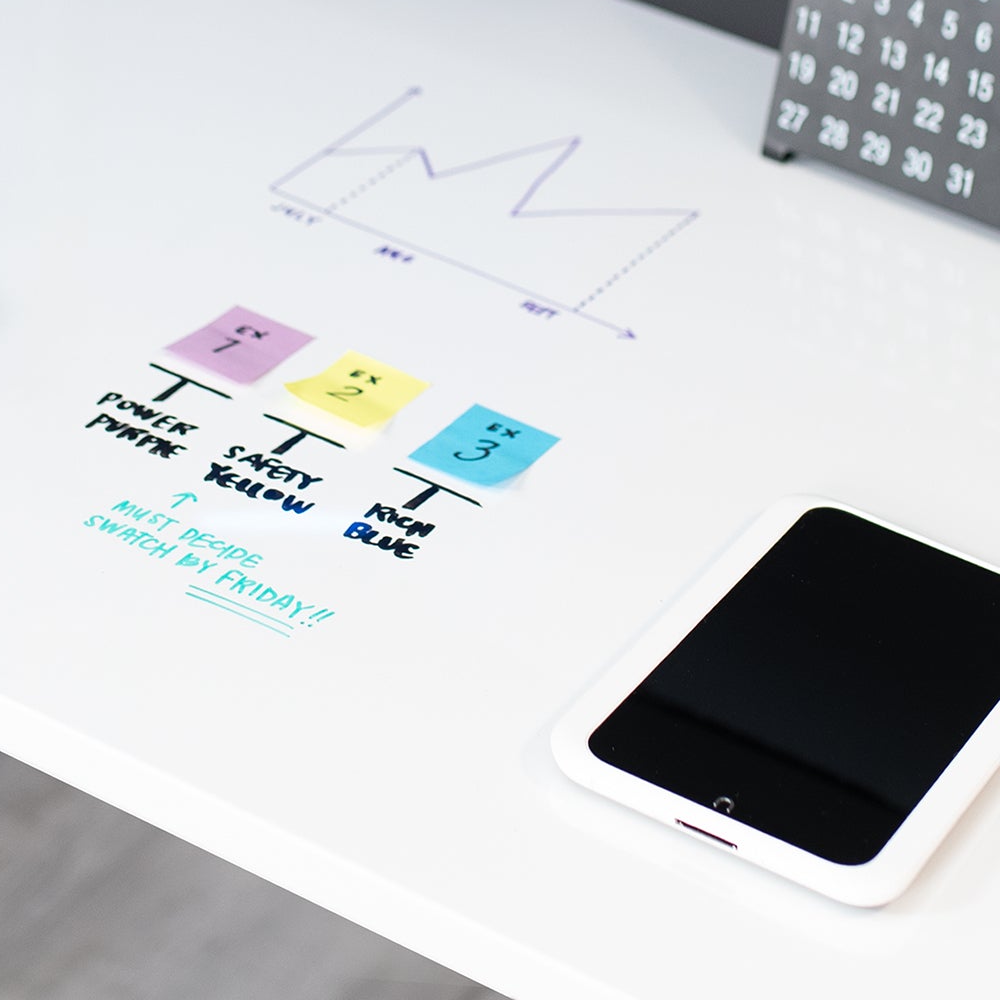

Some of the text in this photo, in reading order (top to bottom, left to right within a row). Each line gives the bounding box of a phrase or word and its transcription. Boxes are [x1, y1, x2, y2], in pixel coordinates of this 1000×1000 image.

[940, 9, 959, 41] 5
[974, 21, 994, 53] 6
[795, 5, 995, 103] 11 12 13 14 15
[788, 51, 988, 149] 19 20 21 22 23
[777, 99, 975, 198] 27 28 29 30 31
[212, 336, 242, 353] 1
[235, 325, 269, 340] EX
[326, 385, 364, 402] 2
[349, 369, 382, 386] EX
[96, 392, 200, 436] POWER
[486, 422, 521, 439] EX
[223, 445, 324, 490] SAFETY
[452, 438, 501, 462] 3
[203, 462, 316, 515] YELLOW
[111, 499, 264, 569] MUST DECIDE
[343, 521, 421, 560] BLUE
[363, 502, 436, 538] RICH
[83, 514, 336, 628] SWATCH BY FRIDAY!!
